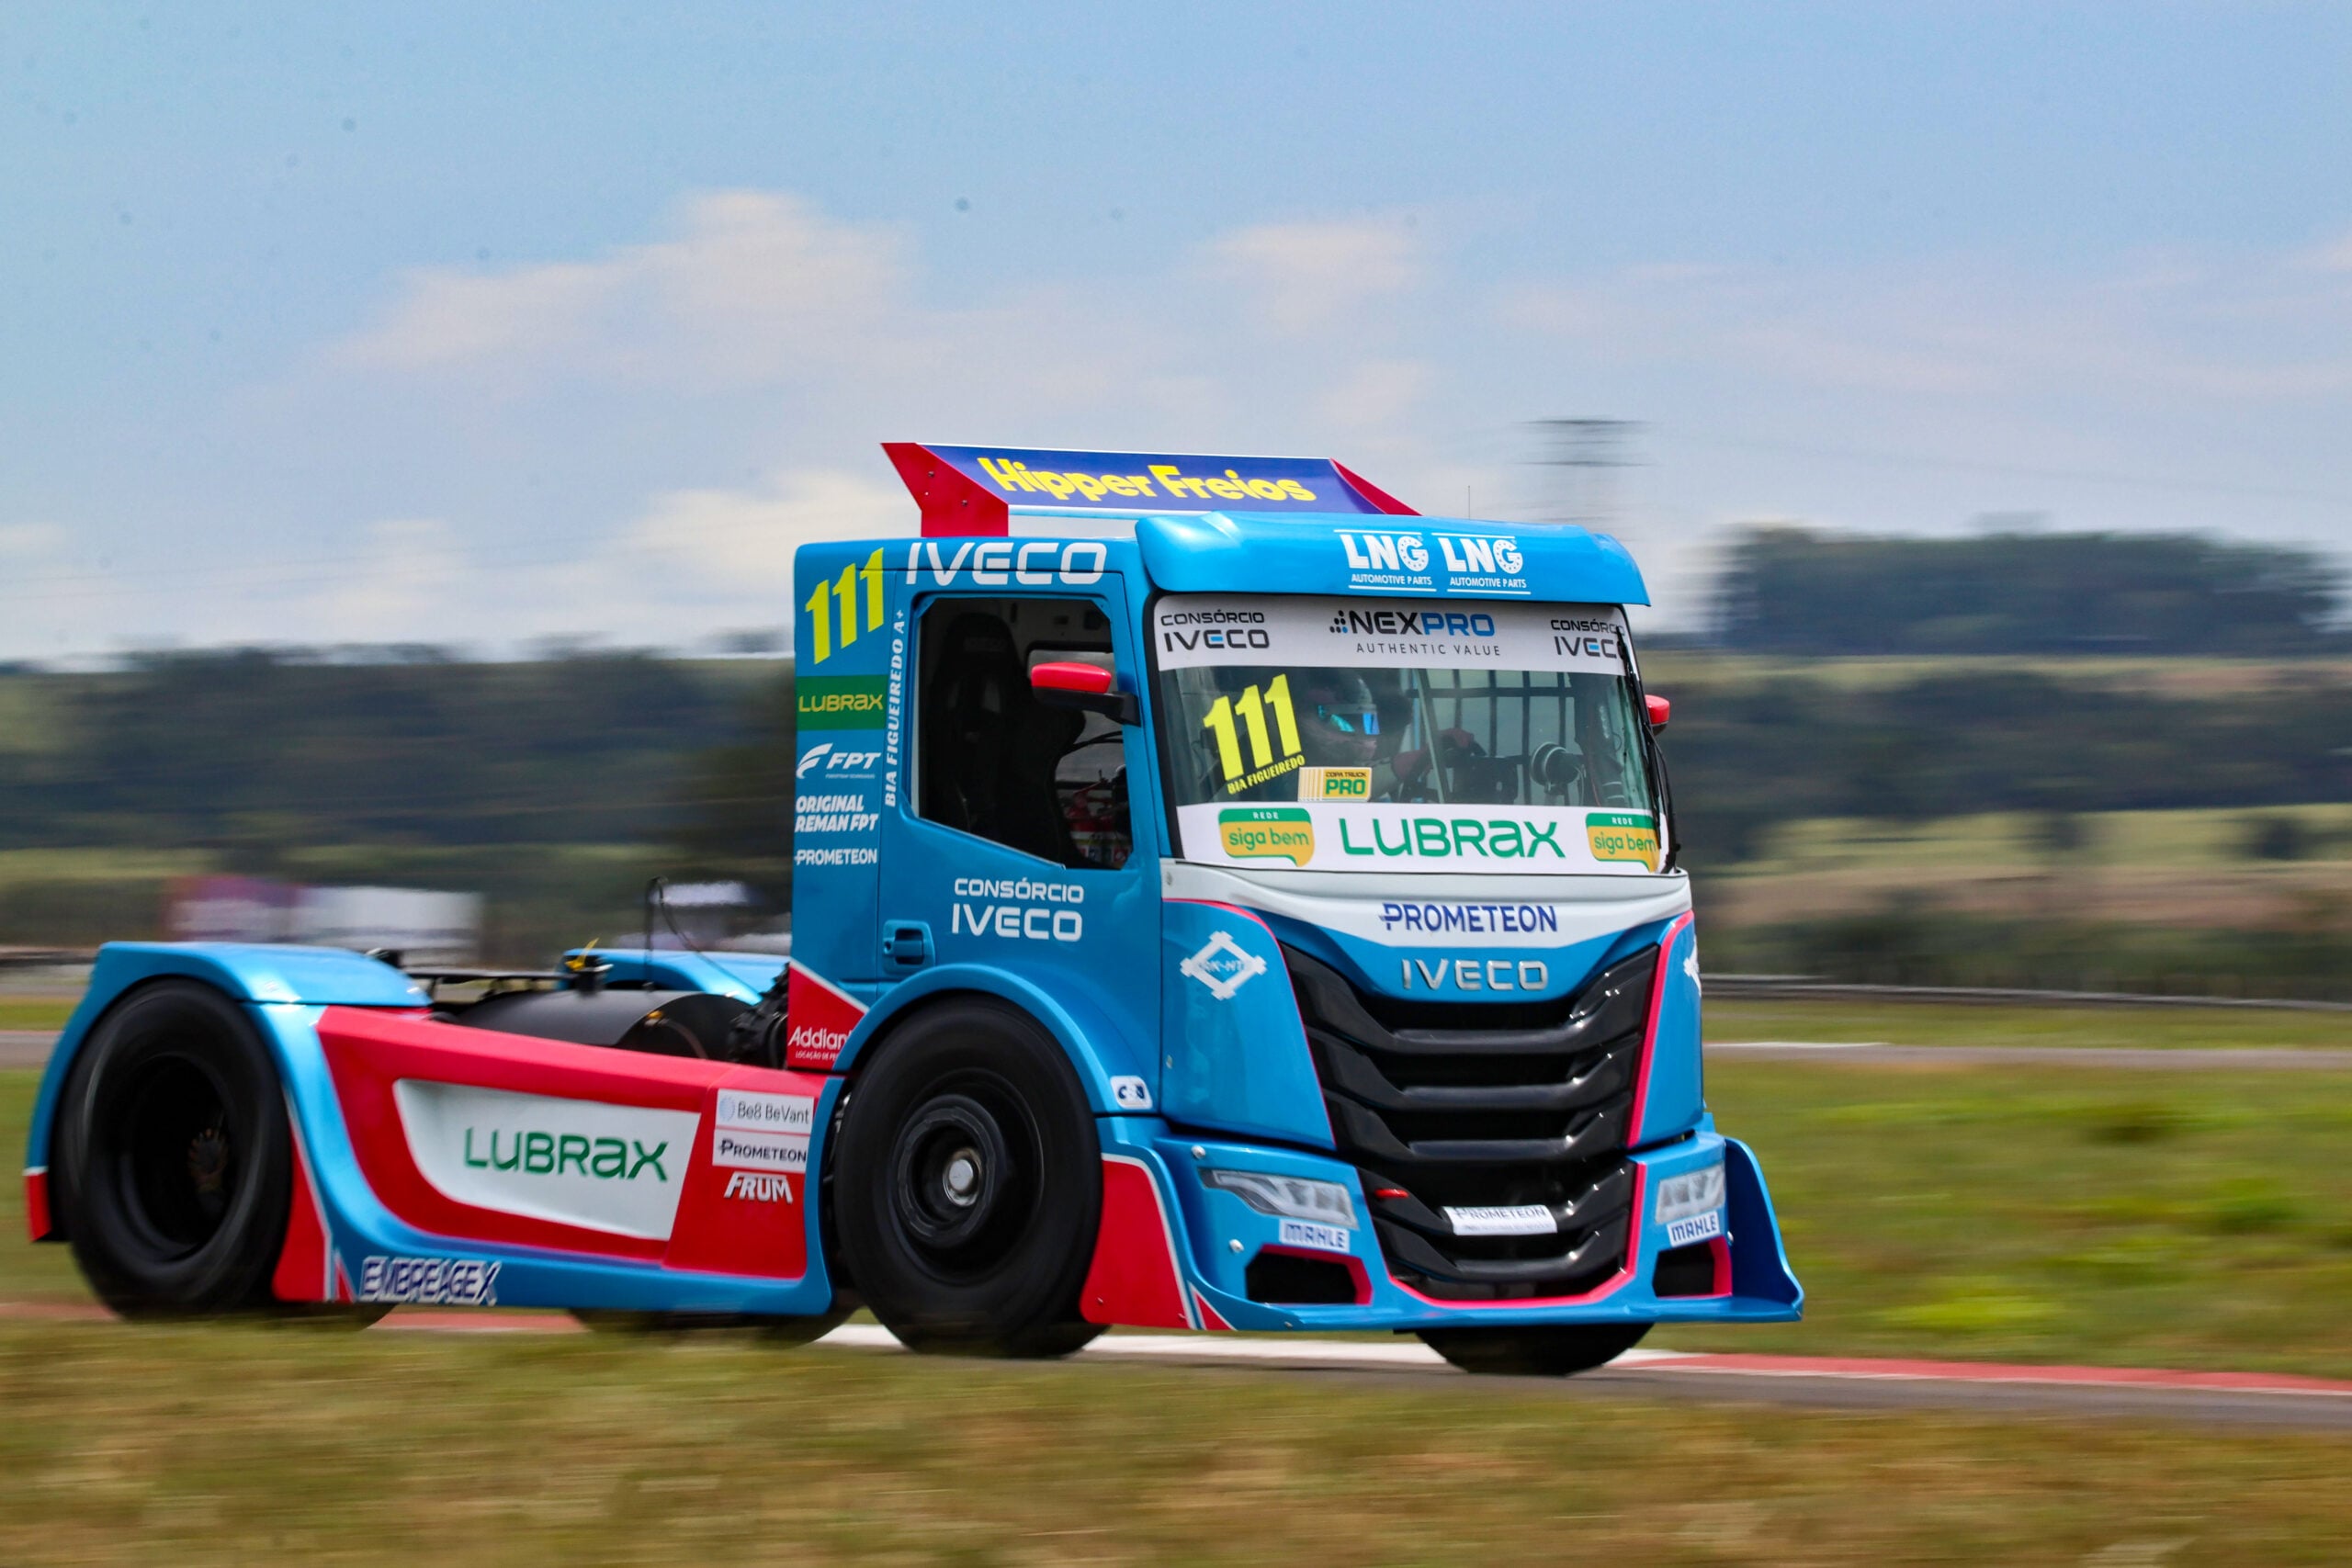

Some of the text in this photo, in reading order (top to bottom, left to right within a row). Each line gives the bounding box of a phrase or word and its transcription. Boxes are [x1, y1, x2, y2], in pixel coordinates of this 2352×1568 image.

[977, 457, 1317, 501] Hipper Freios
[906, 542, 1108, 586] IVECO
[1340, 534, 1523, 574] LNG LNG
[1351, 574, 1432, 585] AUTOMOTIVE PARTS
[1450, 577, 1527, 589] AUTOMOTIVE PARTS
[805, 547, 884, 665] 111
[1160, 609, 1265, 626] CONSÓRCIO
[1349, 611, 1496, 637] NEXPRO
[1550, 618, 1624, 637] CONSÓRCO
[1163, 629, 1270, 652] IVECO
[1356, 643, 1500, 656] AUTHENTIC VALUE
[1554, 636, 1623, 660] IVEC
[887, 639, 903, 765] FIGUEIREDO
[1203, 673, 1302, 781] 111
[826, 751, 882, 770] FPT
[1227, 755, 1306, 795] BIA FIGUEIREDO
[1326, 779, 1365, 795] PRO
[886, 772, 897, 807] BIA
[796, 795, 865, 813] ORIGINAL
[795, 813, 879, 833] REMAN FPT
[1611, 817, 1633, 825] REDE
[1228, 828, 1309, 851] siga bem
[1594, 831, 1657, 854] siga bem
[794, 848, 877, 866] PROMETEON
[954, 877, 1084, 903] CONSÓRCIO
[952, 903, 1082, 942] IVECO
[1379, 902, 1558, 933] PROMETEON
[1401, 958, 1549, 991] IVECO
[738, 1101, 809, 1124] Be8 BeVant
[718, 1138, 807, 1163] PROMETEON
[723, 1171, 793, 1204] FRUM
[1453, 1205, 1547, 1220] PROMETEON
[1284, 1224, 1345, 1248] MAHLE
[1671, 1214, 1717, 1242] MAHLE
